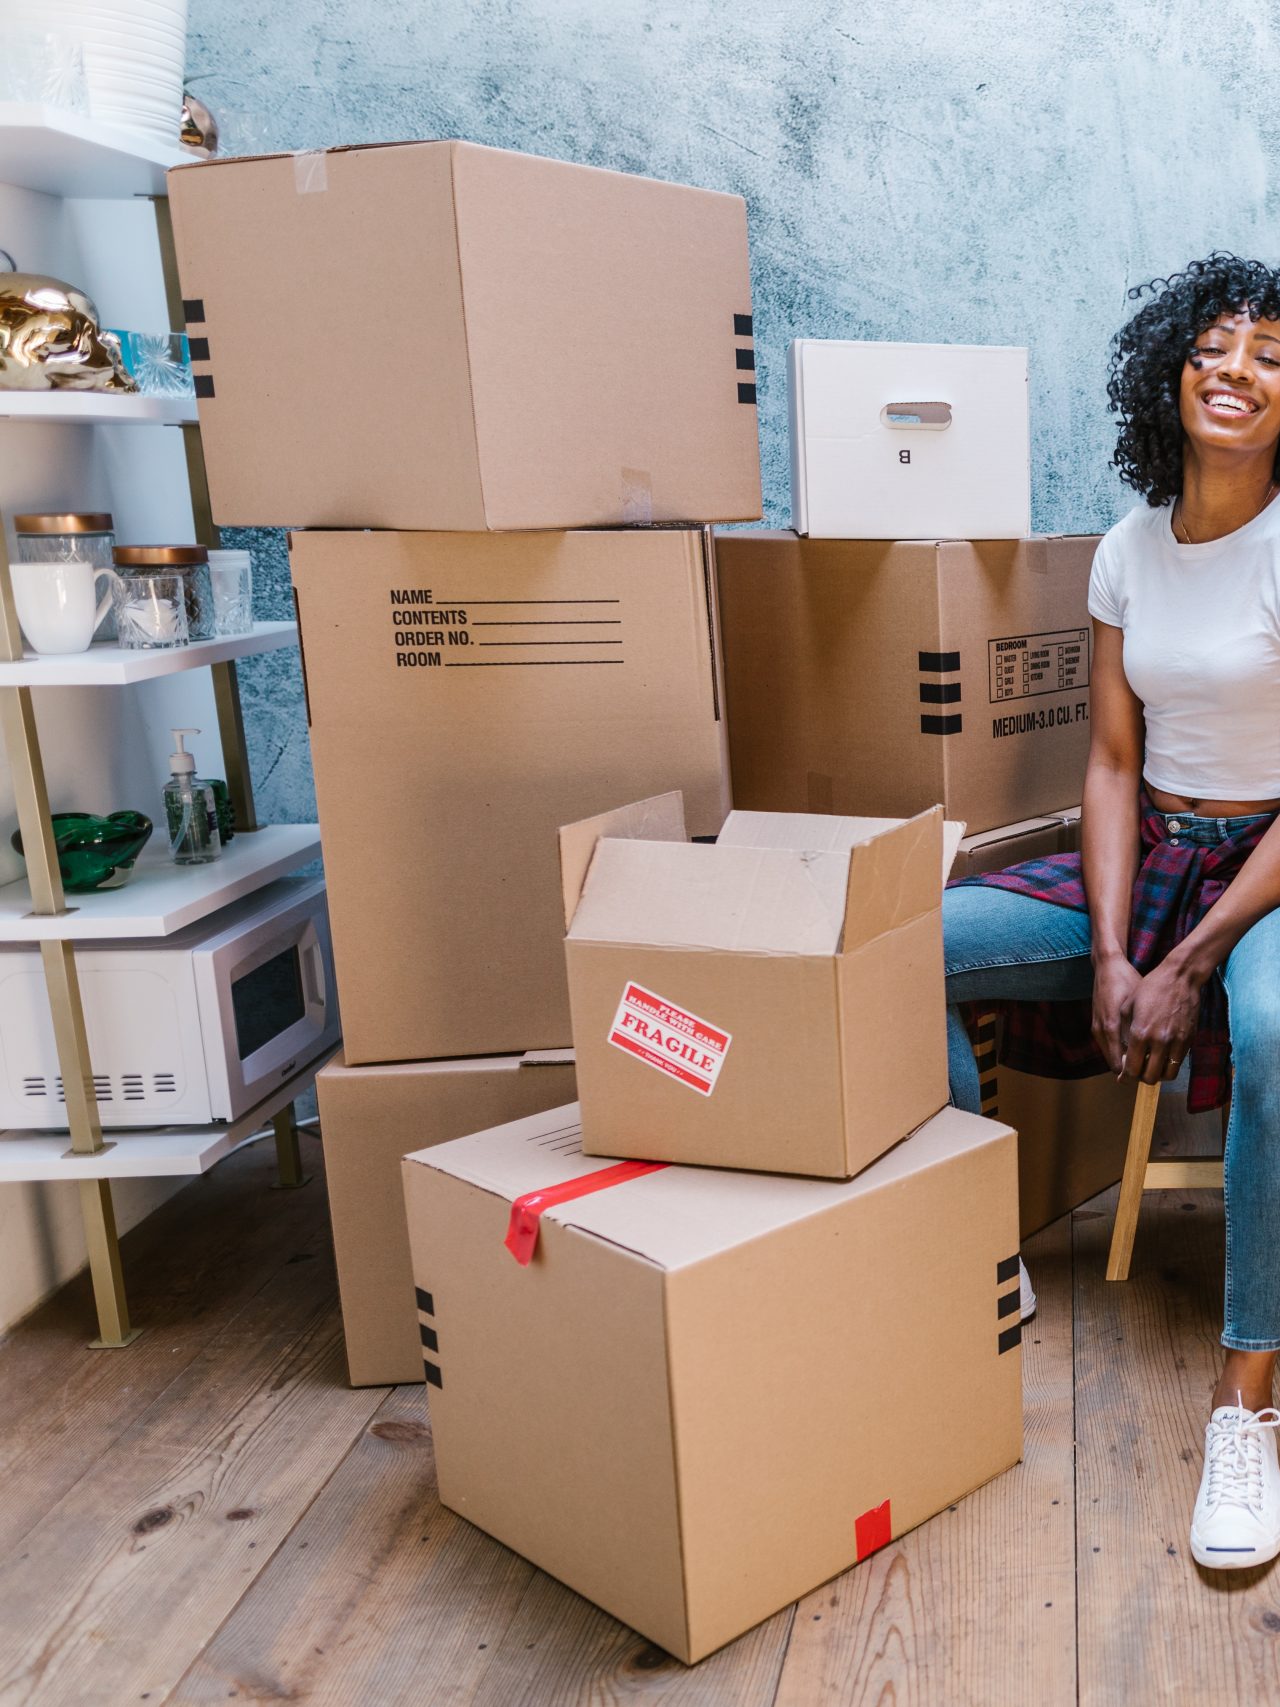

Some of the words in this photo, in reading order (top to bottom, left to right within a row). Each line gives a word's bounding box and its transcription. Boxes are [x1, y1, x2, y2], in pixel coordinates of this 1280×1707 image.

[899, 449, 910, 464] B
[390, 589, 433, 604] NAME
[392, 610, 468, 625] CONTENTS
[394, 631, 445, 646] ORDER
[448, 631, 474, 646] NO.
[996, 640, 1027, 652] BEDROOM
[396, 652, 442, 667] ROOM
[992, 708, 1055, 739] MEDIUM-3.0
[1057, 705, 1073, 725] CU.
[1075, 702, 1089, 722] FT.
[627, 995, 669, 1021] HANDLE
[668, 1015, 696, 1037] WITH
[695, 1032, 723, 1050] CARE
[659, 1004, 696, 1028] PLEASE
[620, 1011, 716, 1073] FRAGILE
